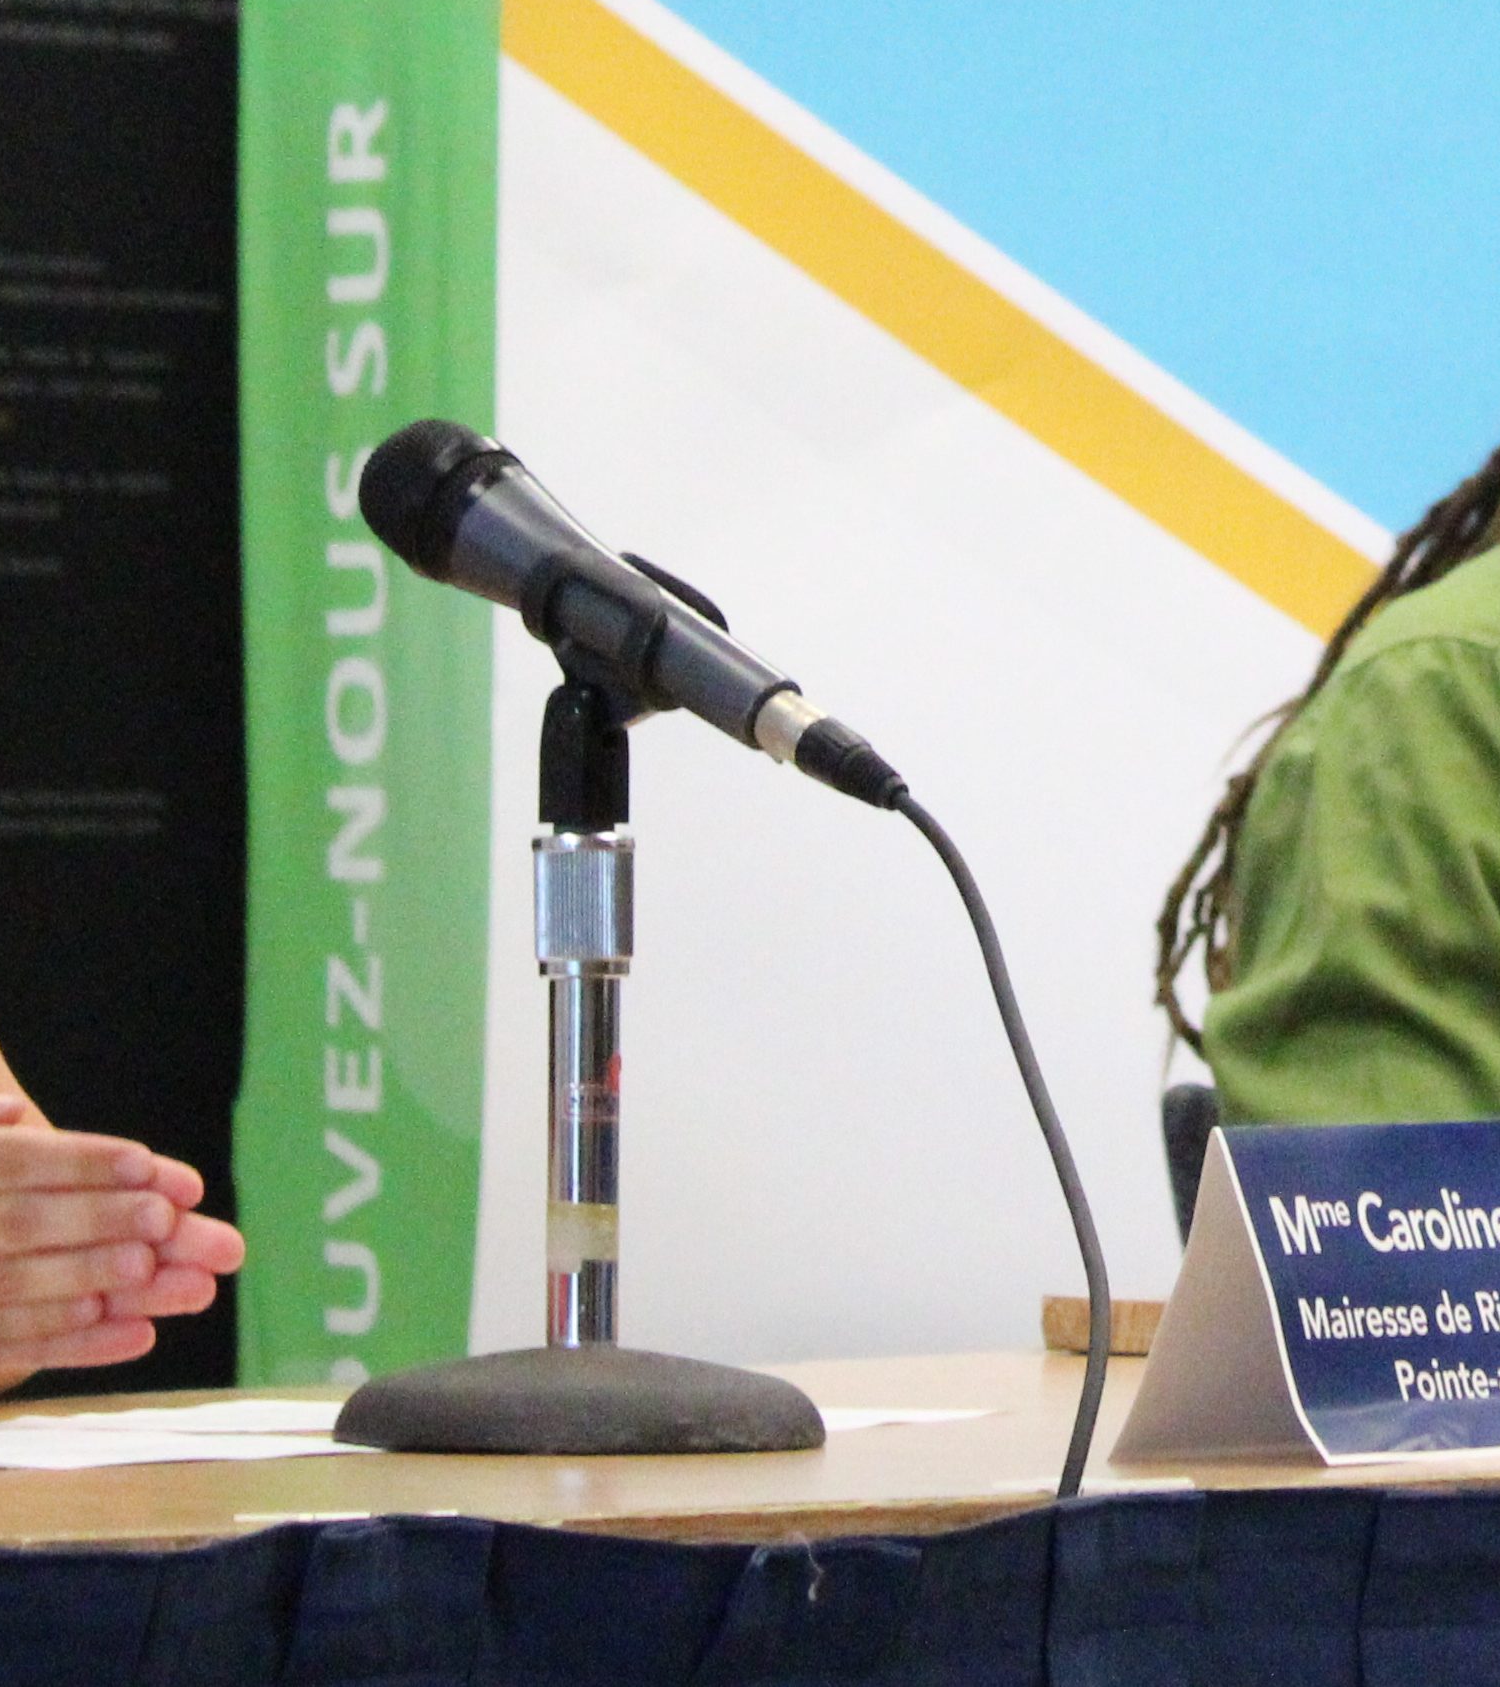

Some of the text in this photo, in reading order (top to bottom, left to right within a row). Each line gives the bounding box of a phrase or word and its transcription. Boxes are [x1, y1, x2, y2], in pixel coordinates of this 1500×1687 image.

[322, 98, 390, 1388] UVEZ-NOUS SUR
[1268, 1192, 1351, 1256] Mme
[1297, 1294, 1429, 1341] Mairesse
[1434, 1294, 1474, 1337] de
